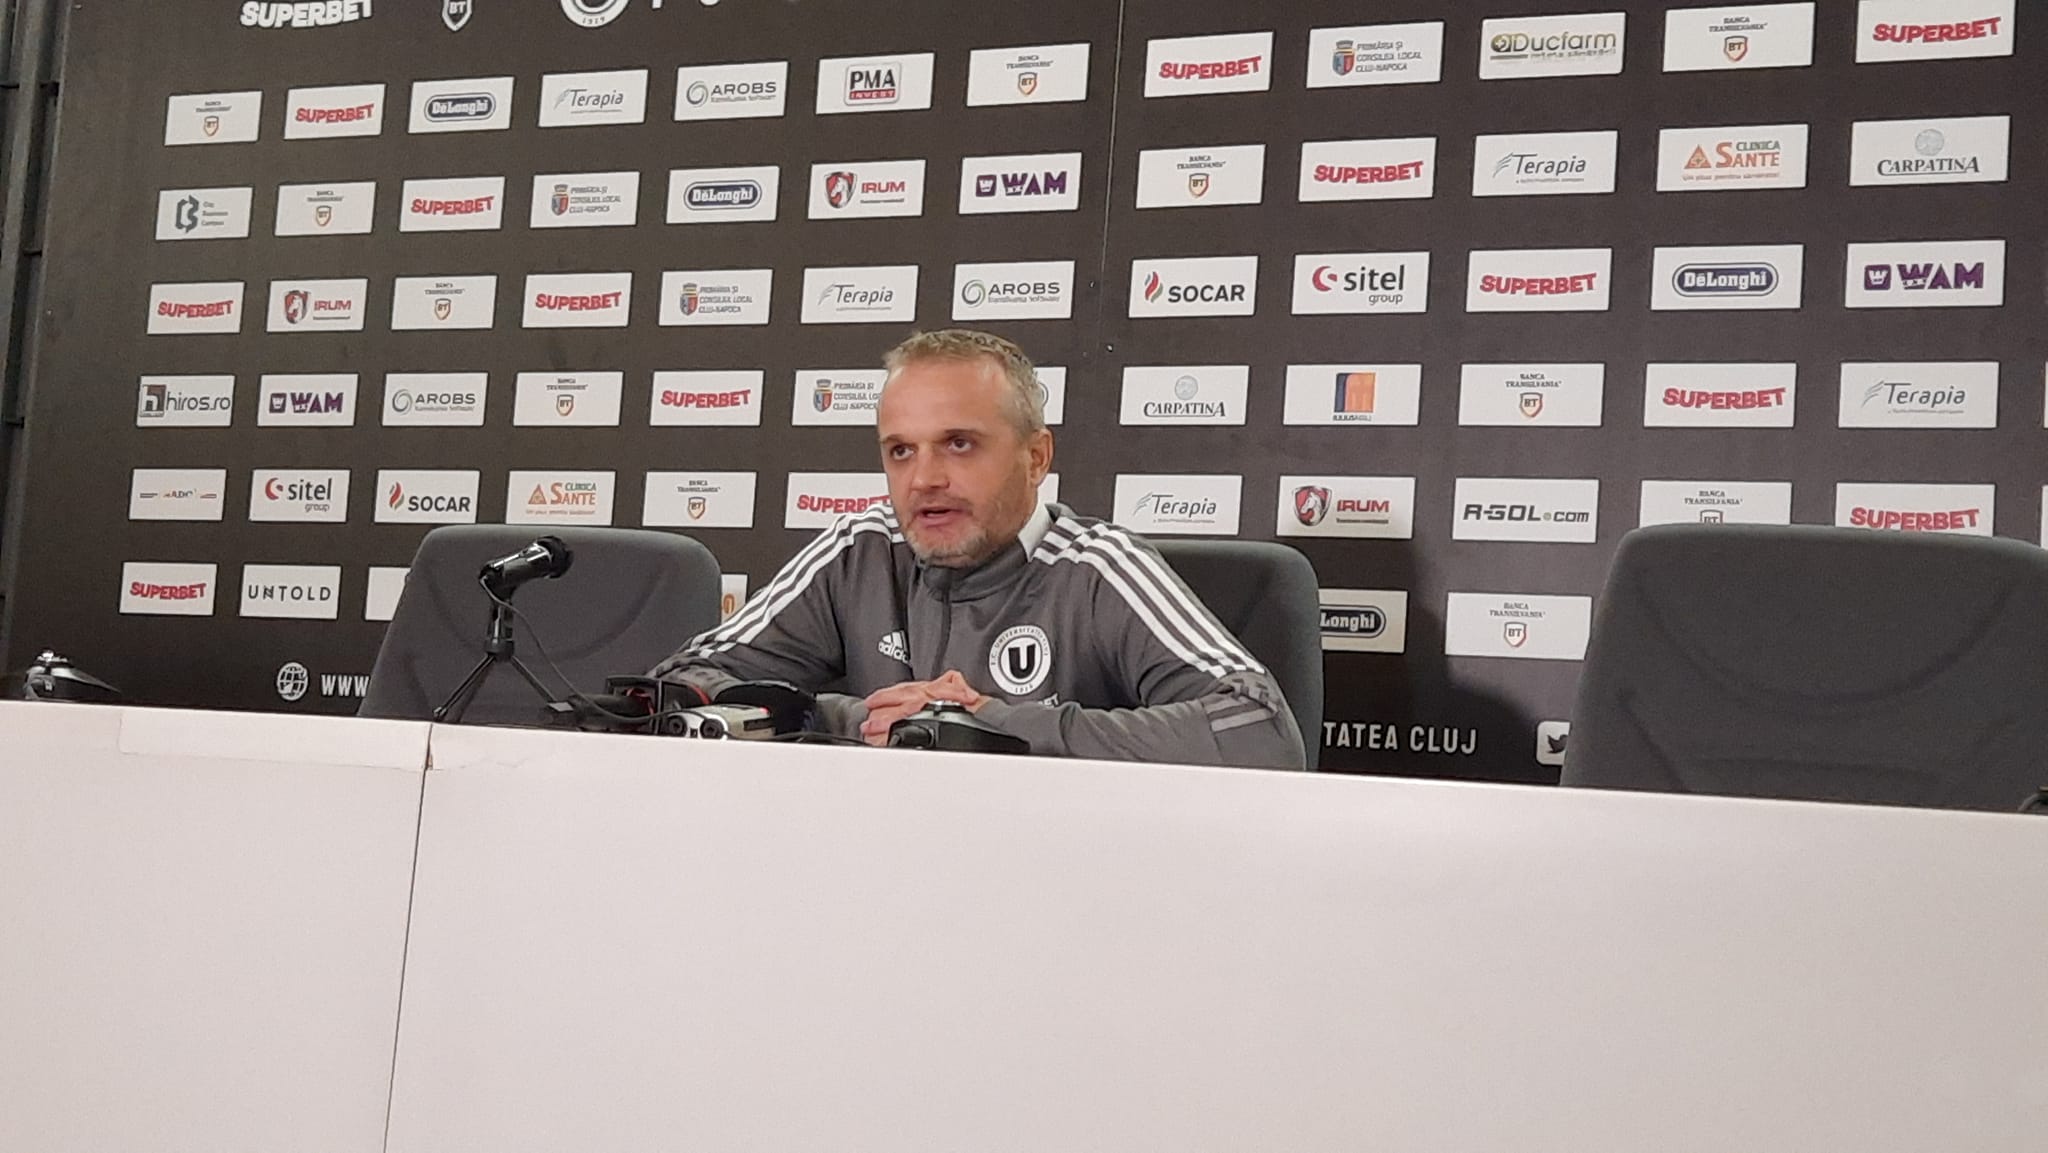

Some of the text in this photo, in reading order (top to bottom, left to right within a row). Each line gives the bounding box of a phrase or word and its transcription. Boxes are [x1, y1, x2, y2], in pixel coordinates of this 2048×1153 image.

[241, 0, 372, 28] SUPERBET
[1873, 17, 2000, 42] SUPERBET
[1514, 31, 1617, 52] Ducfarm
[1728, 43, 1742, 52] BT
[1160, 55, 1262, 79] SUPERBET
[711, 82, 776, 95] AROBS
[849, 69, 896, 90] PMA
[569, 89, 623, 108] Terapia
[297, 104, 373, 122] SUPERBET
[1513, 153, 1586, 176] Terapia
[1716, 142, 1780, 168] SANTE
[1314, 160, 1424, 183] SUPERBET
[1877, 156, 1980, 176] CARPATINA
[861, 181, 905, 194] IRUM
[1001, 171, 1067, 196] WAM
[1192, 179, 1204, 187] BT
[412, 196, 493, 214] SUPERBET
[1343, 264, 1405, 291] sitel
[1480, 272, 1597, 295] SUPERBET
[1897, 262, 1984, 290] WAM
[833, 284, 893, 306] Terapia
[988, 282, 1060, 296] AROBS
[1168, 284, 1245, 303] SOCAR
[159, 300, 233, 317] SUPERBET
[314, 300, 351, 311] IRUM
[536, 292, 621, 310] SUPERBET
[1369, 294, 1403, 306] group
[166, 391, 232, 412] hiros.ro
[290, 392, 344, 413] WAM
[415, 393, 475, 404] AROBS
[661, 389, 750, 408] SUPERBET
[1524, 398, 1538, 407] BT
[1663, 387, 1786, 408] SUPERBET
[1883, 382, 1965, 407] Terapia
[1143, 402, 1225, 417] CARPATINA
[287, 478, 332, 500] sitel
[551, 482, 596, 506] SANTE
[305, 504, 330, 512] group
[408, 496, 470, 512] SOCAR
[691, 502, 702, 510] BT
[1152, 495, 1216, 517] Terapia
[1337, 500, 1389, 513] IRUM
[1851, 507, 1979, 530] SUPERBET
[131, 581, 206, 599] SUPERBET
[248, 585, 331, 601] UNTOLD
[1507, 628, 1522, 637] BT
[878, 641, 909, 664] adida
[1008, 643, 1036, 679] U
[321, 674, 370, 697] WWW
[1323, 721, 1476, 754] TATEA CLUJ
